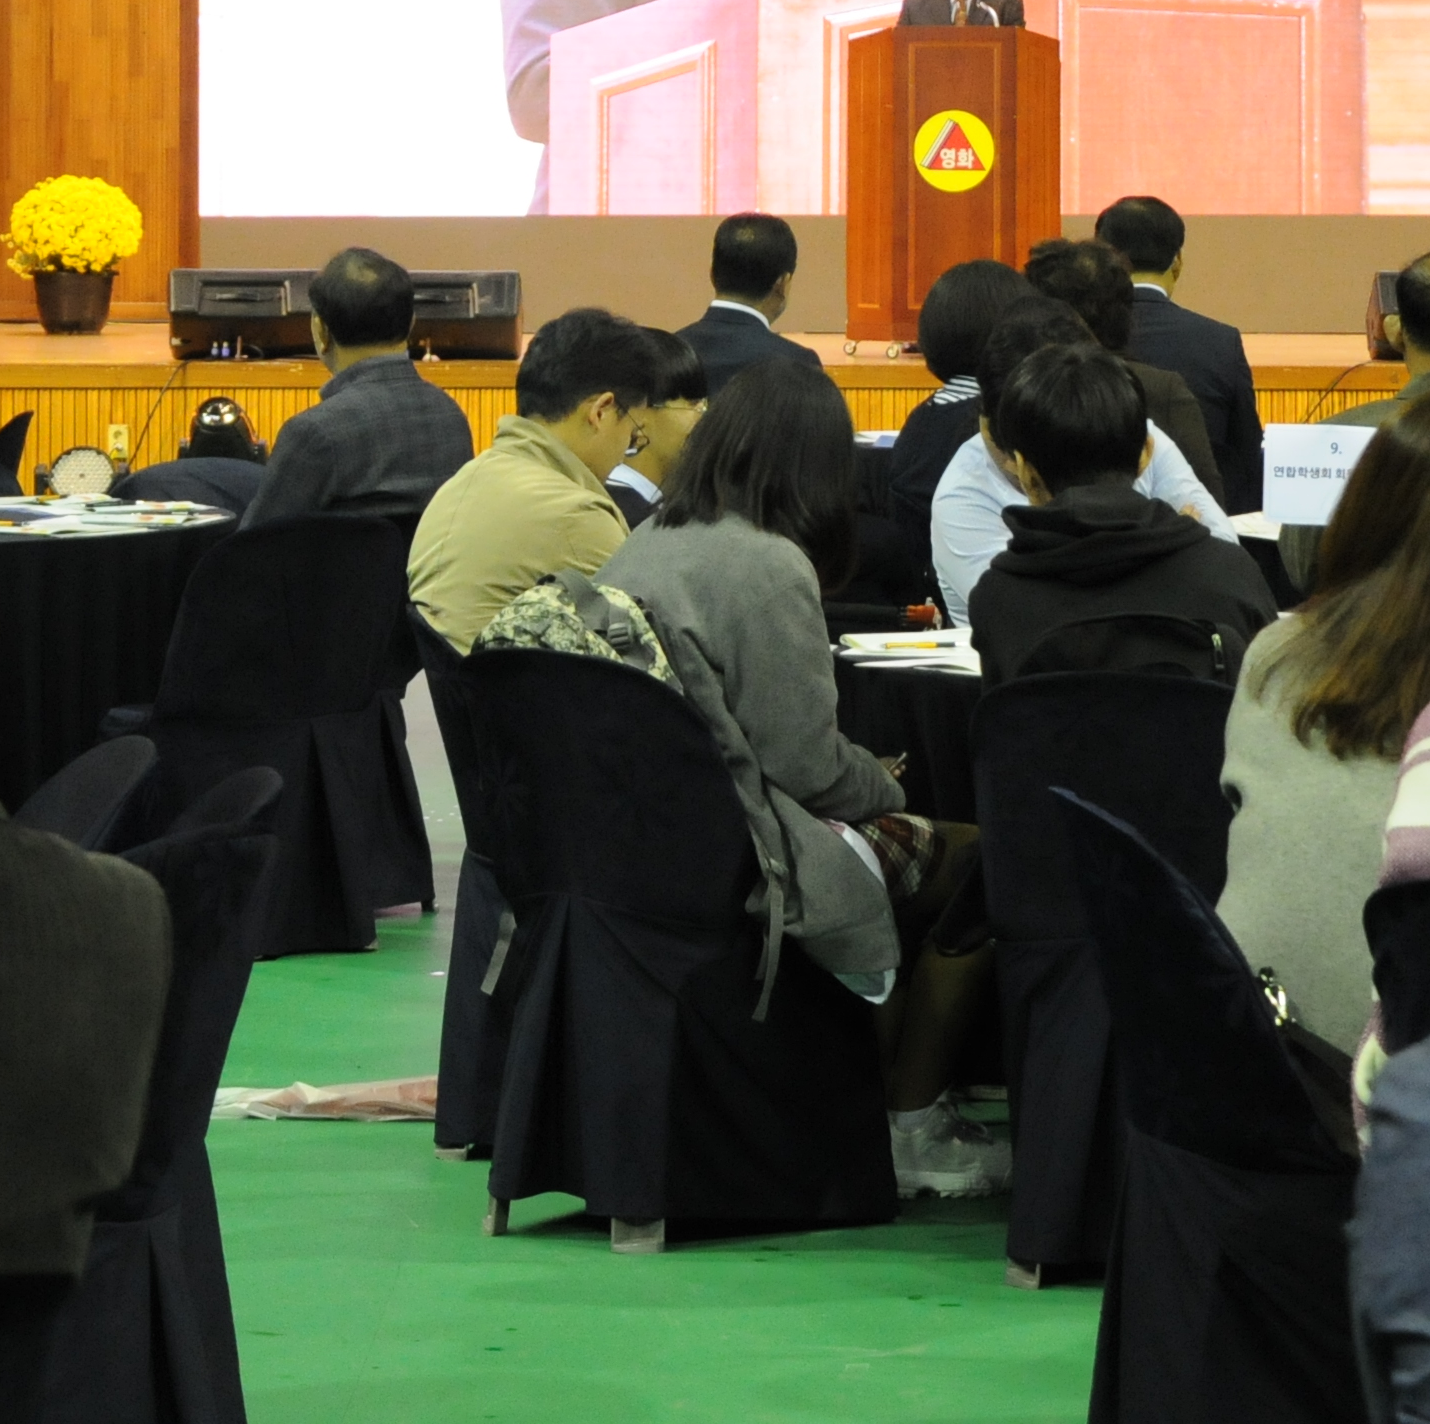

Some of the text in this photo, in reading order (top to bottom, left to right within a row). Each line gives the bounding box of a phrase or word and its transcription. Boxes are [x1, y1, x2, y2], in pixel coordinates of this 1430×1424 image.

[940, 148, 974, 169] 영화
[1330, 441, 1342, 455] 9.
[1273, 465, 1332, 479] 연합학생회
